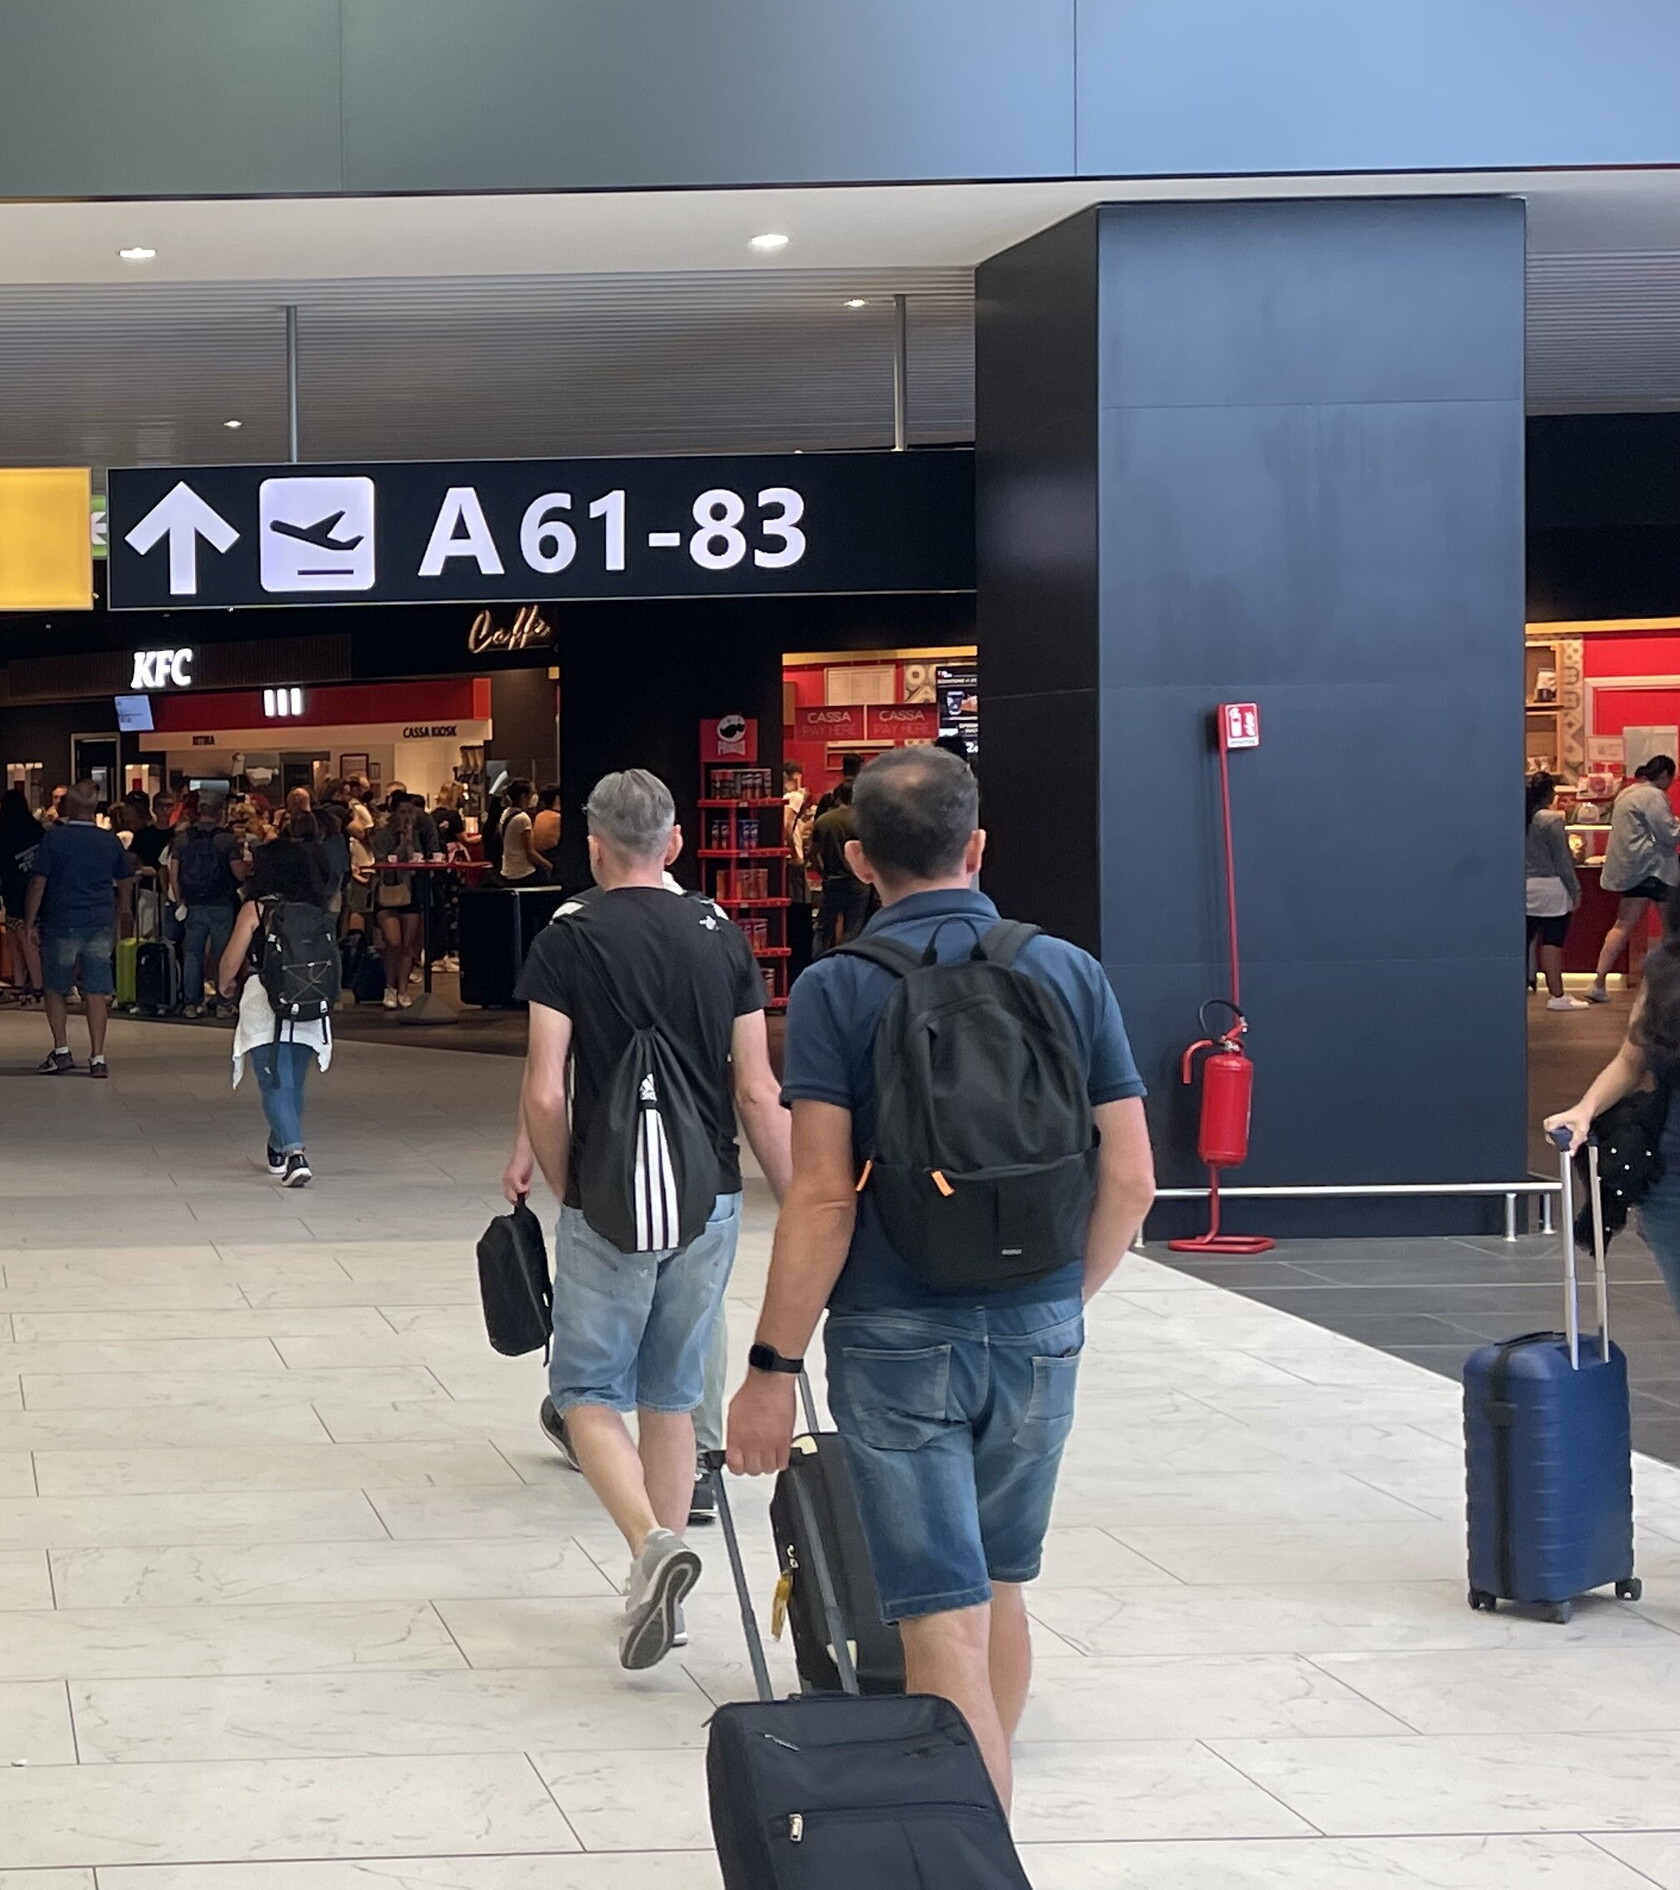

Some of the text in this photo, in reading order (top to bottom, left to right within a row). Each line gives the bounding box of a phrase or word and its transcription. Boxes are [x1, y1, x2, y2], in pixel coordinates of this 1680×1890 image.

[130, 648, 193, 689] KFC
[807, 711, 851, 723] CASSA
[879, 710, 925, 722] CASSA
[802, 725, 826, 736] PAY
[874, 724, 900, 735] PAY
